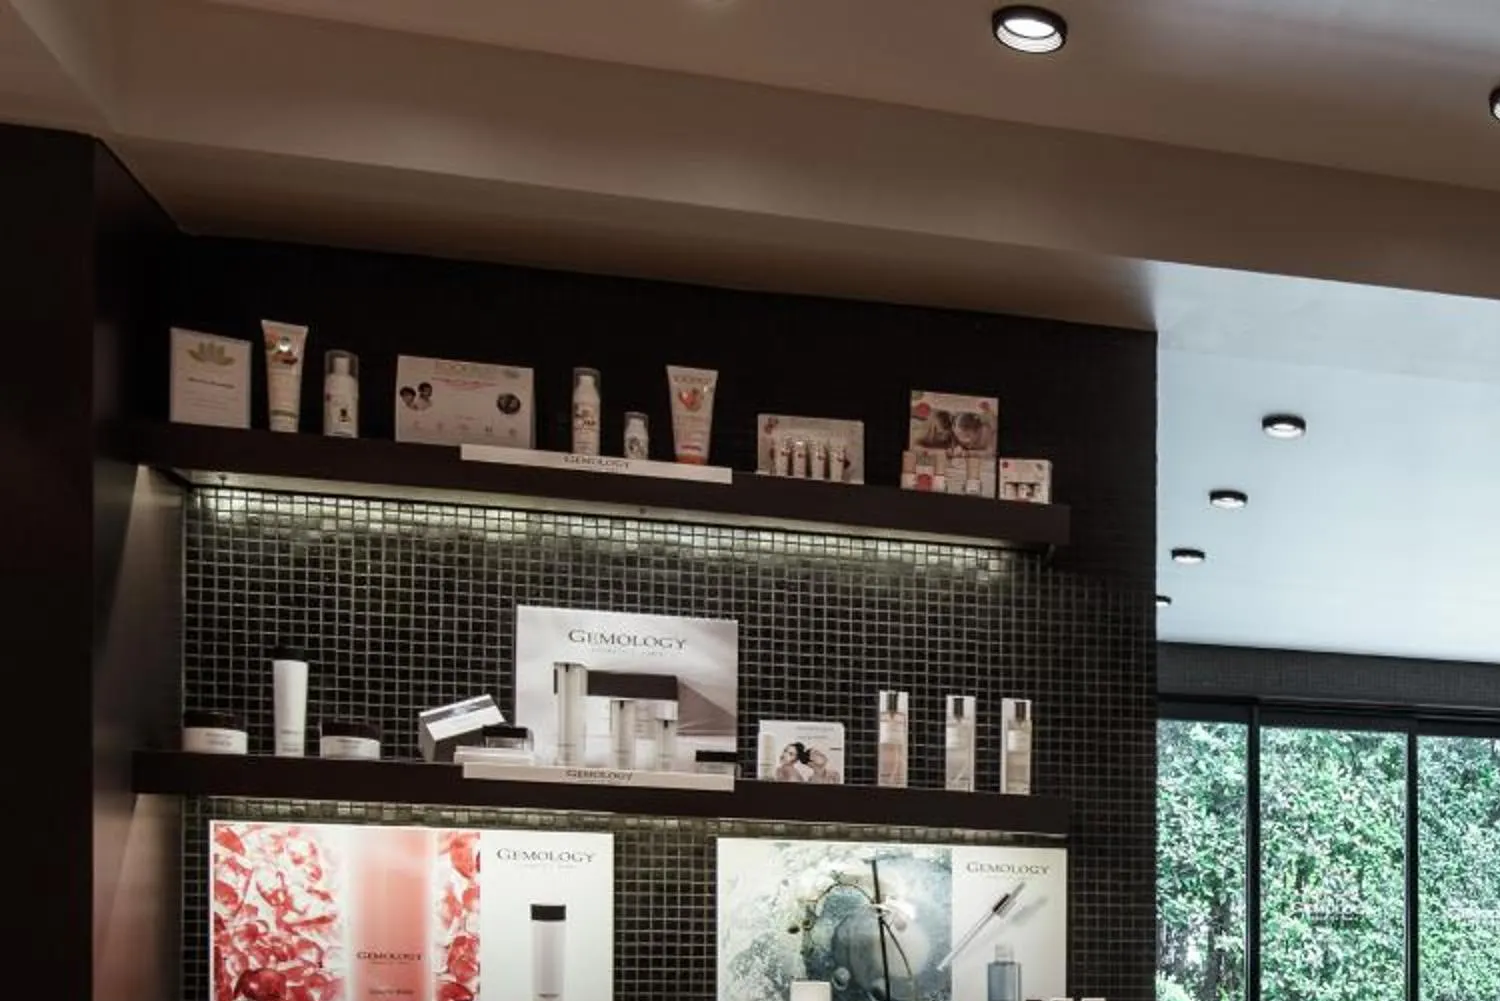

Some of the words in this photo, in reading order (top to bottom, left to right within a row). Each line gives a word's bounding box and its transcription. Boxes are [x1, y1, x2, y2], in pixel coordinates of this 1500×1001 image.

[567, 628, 689, 650] GEMOLOGY
[495, 847, 597, 863] GEMOLOGY
[966, 861, 1050, 875] GEMOLOGY
